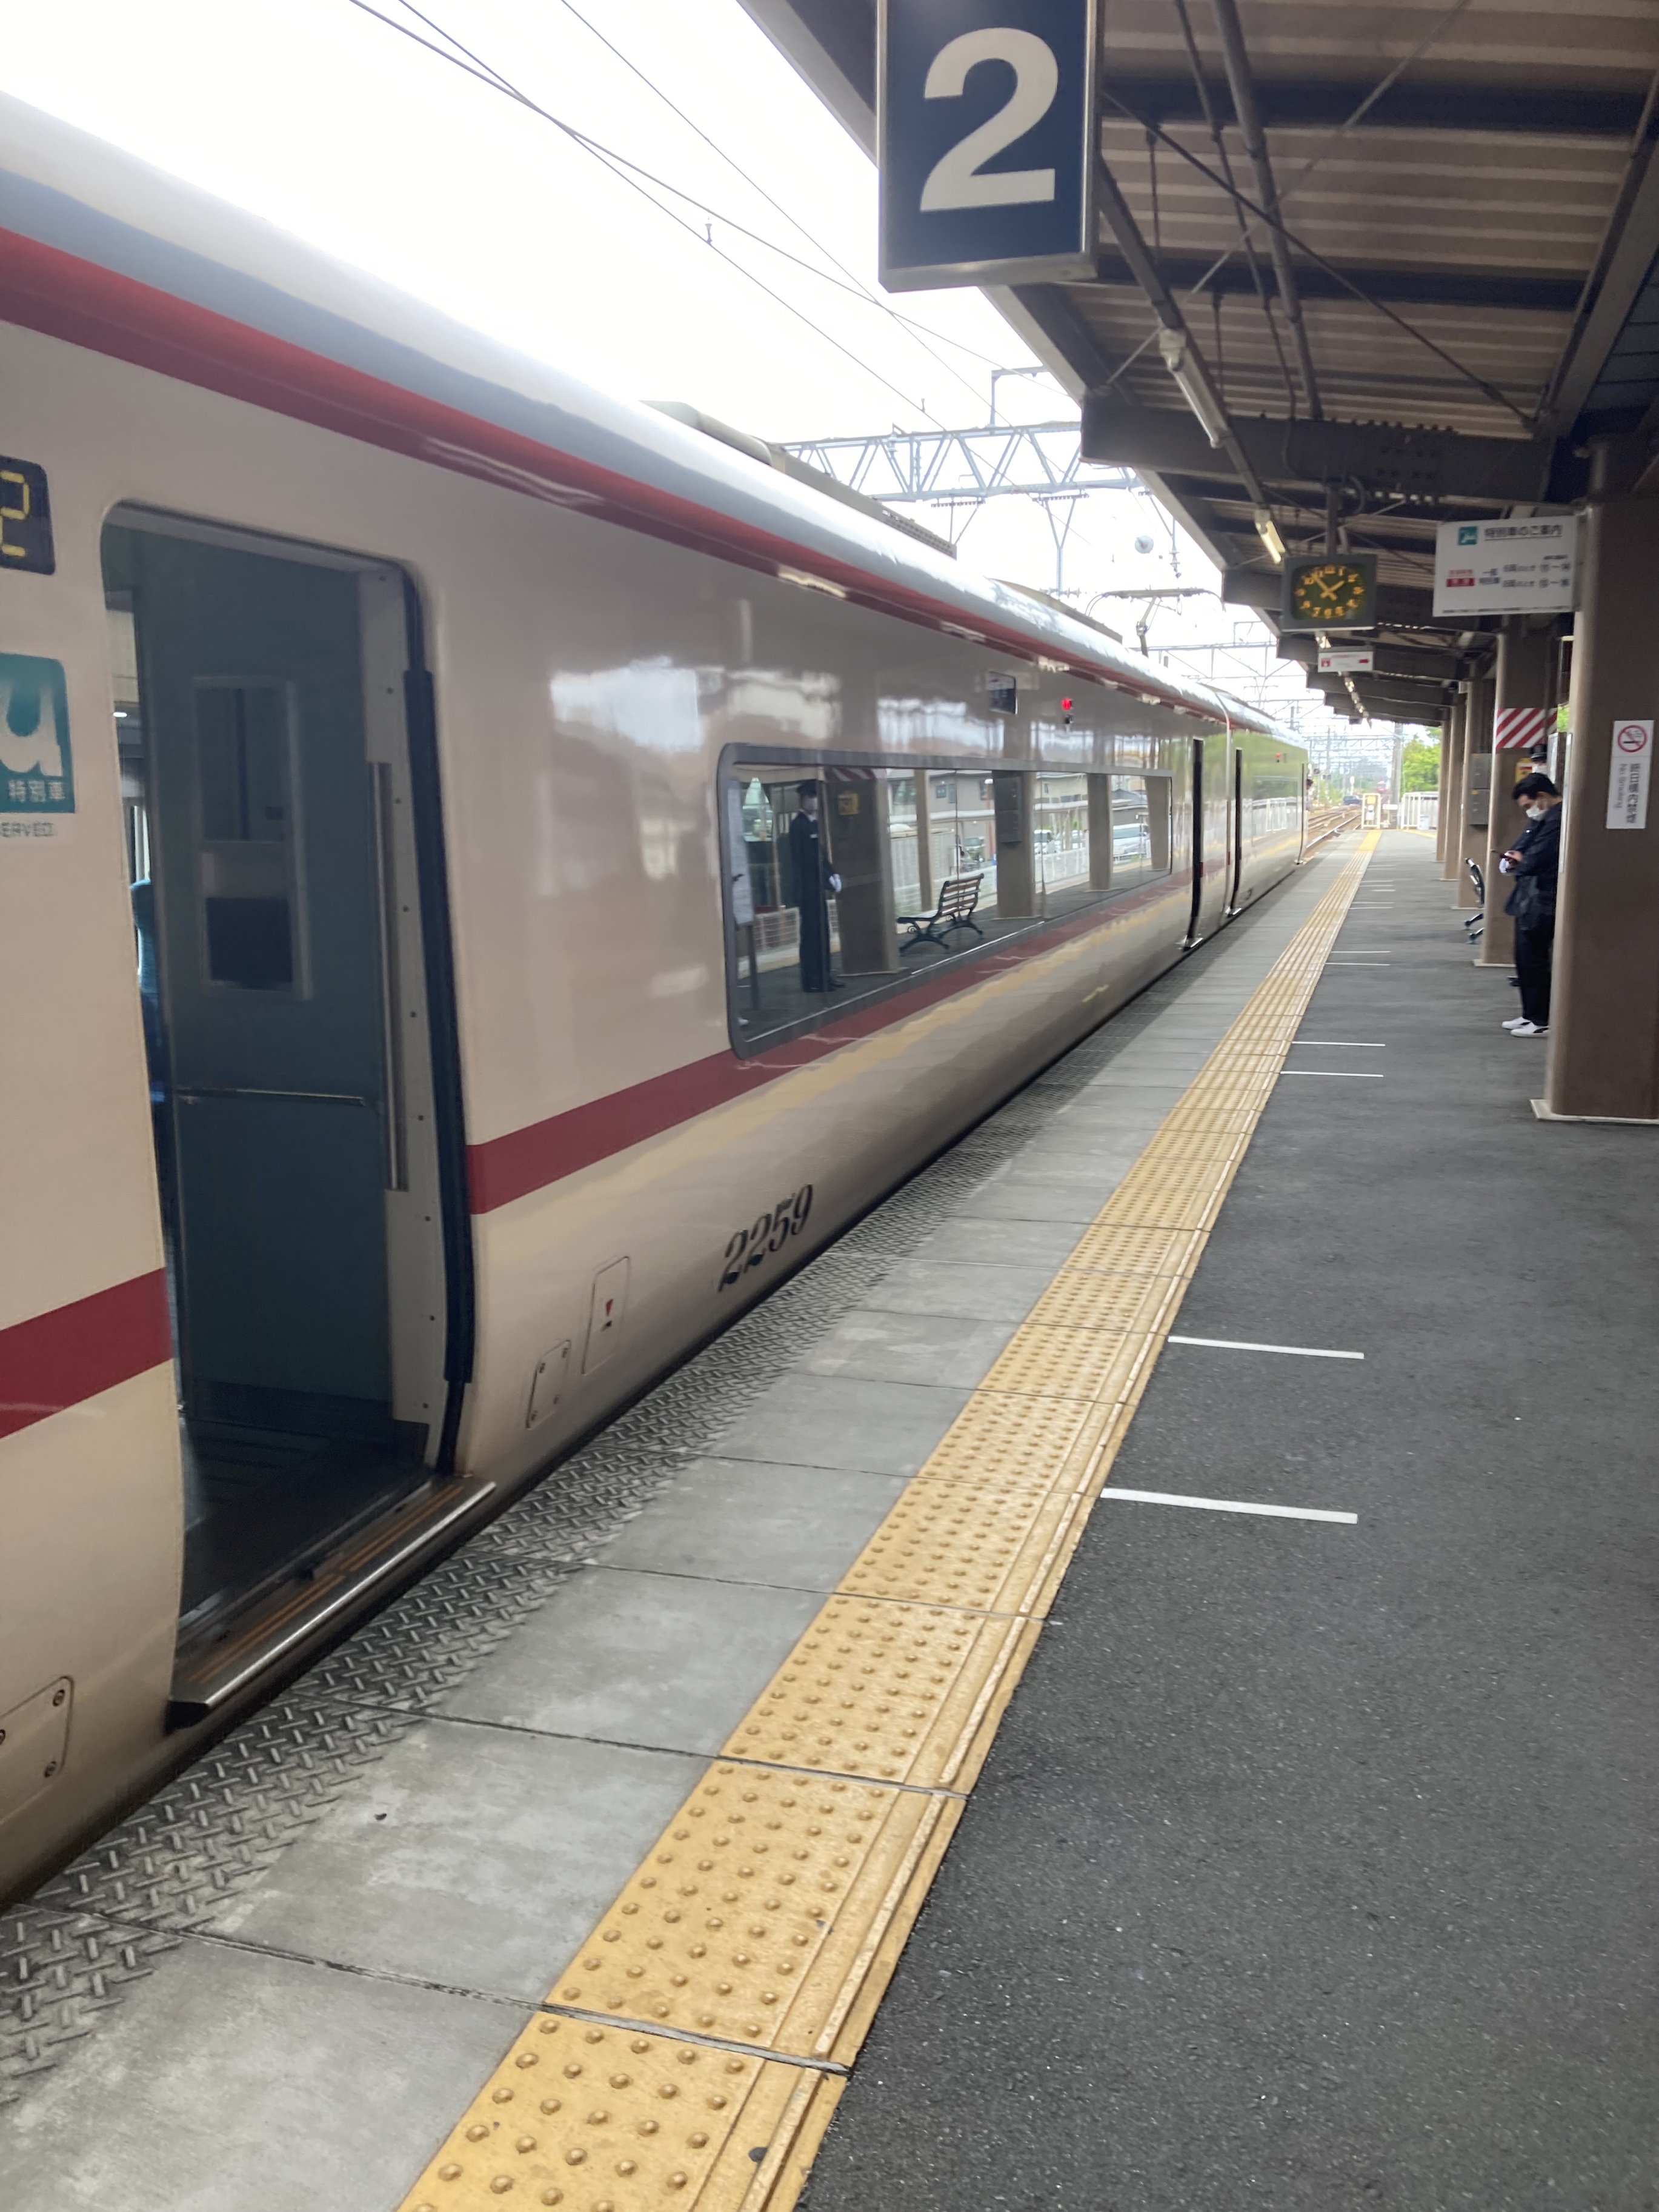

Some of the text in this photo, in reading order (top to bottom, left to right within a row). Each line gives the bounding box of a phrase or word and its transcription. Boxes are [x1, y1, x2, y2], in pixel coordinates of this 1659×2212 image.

[920, 27, 1059, 212] 2
[0, 470, 30, 557] 2
[718, 1183, 813, 1292] 2259
